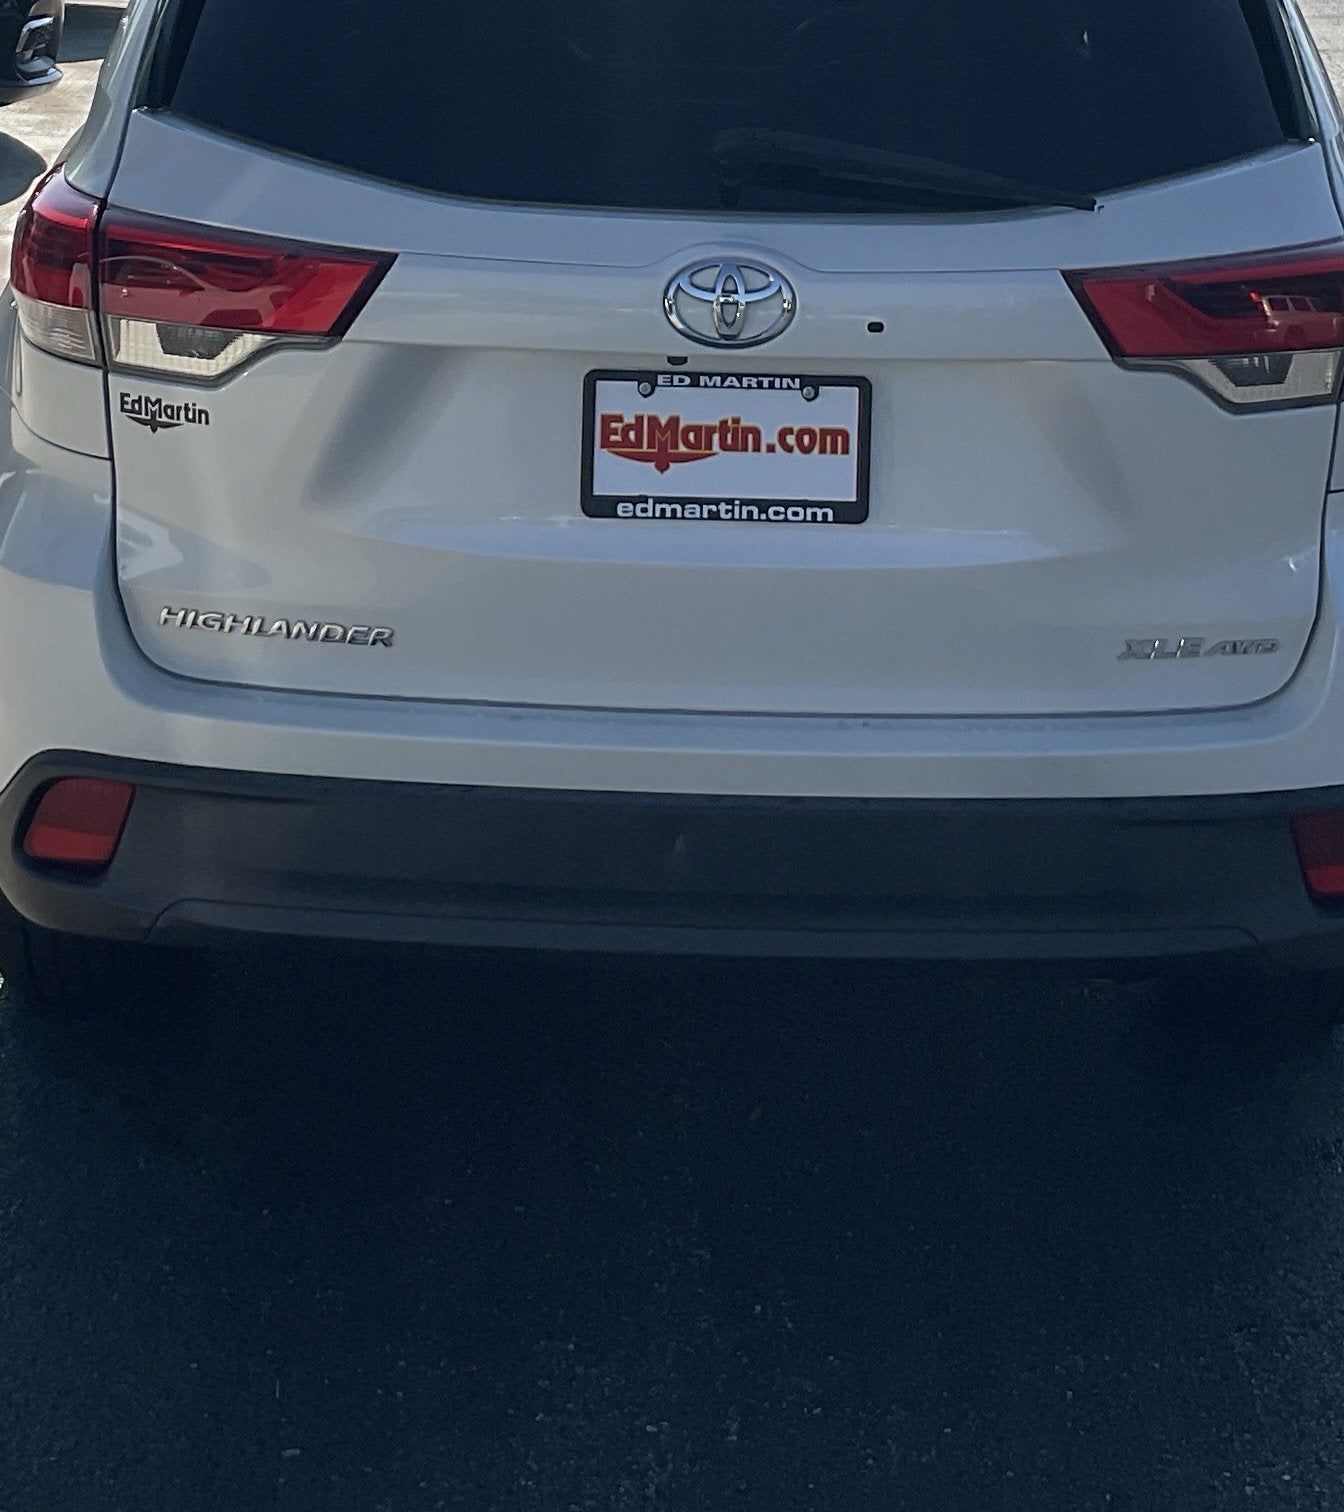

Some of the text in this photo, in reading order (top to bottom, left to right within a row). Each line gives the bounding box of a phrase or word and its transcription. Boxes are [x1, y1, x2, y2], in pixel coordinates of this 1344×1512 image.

[657, 374, 801, 390] ED MARTIN
[119, 392, 210, 426] EdMartin
[600, 413, 850, 457] EdMartin.com
[616, 498, 834, 522] edmartin.com
[159, 606, 395, 647] HIGHLANDER
[1117, 638, 1279, 660] XLE AWD
